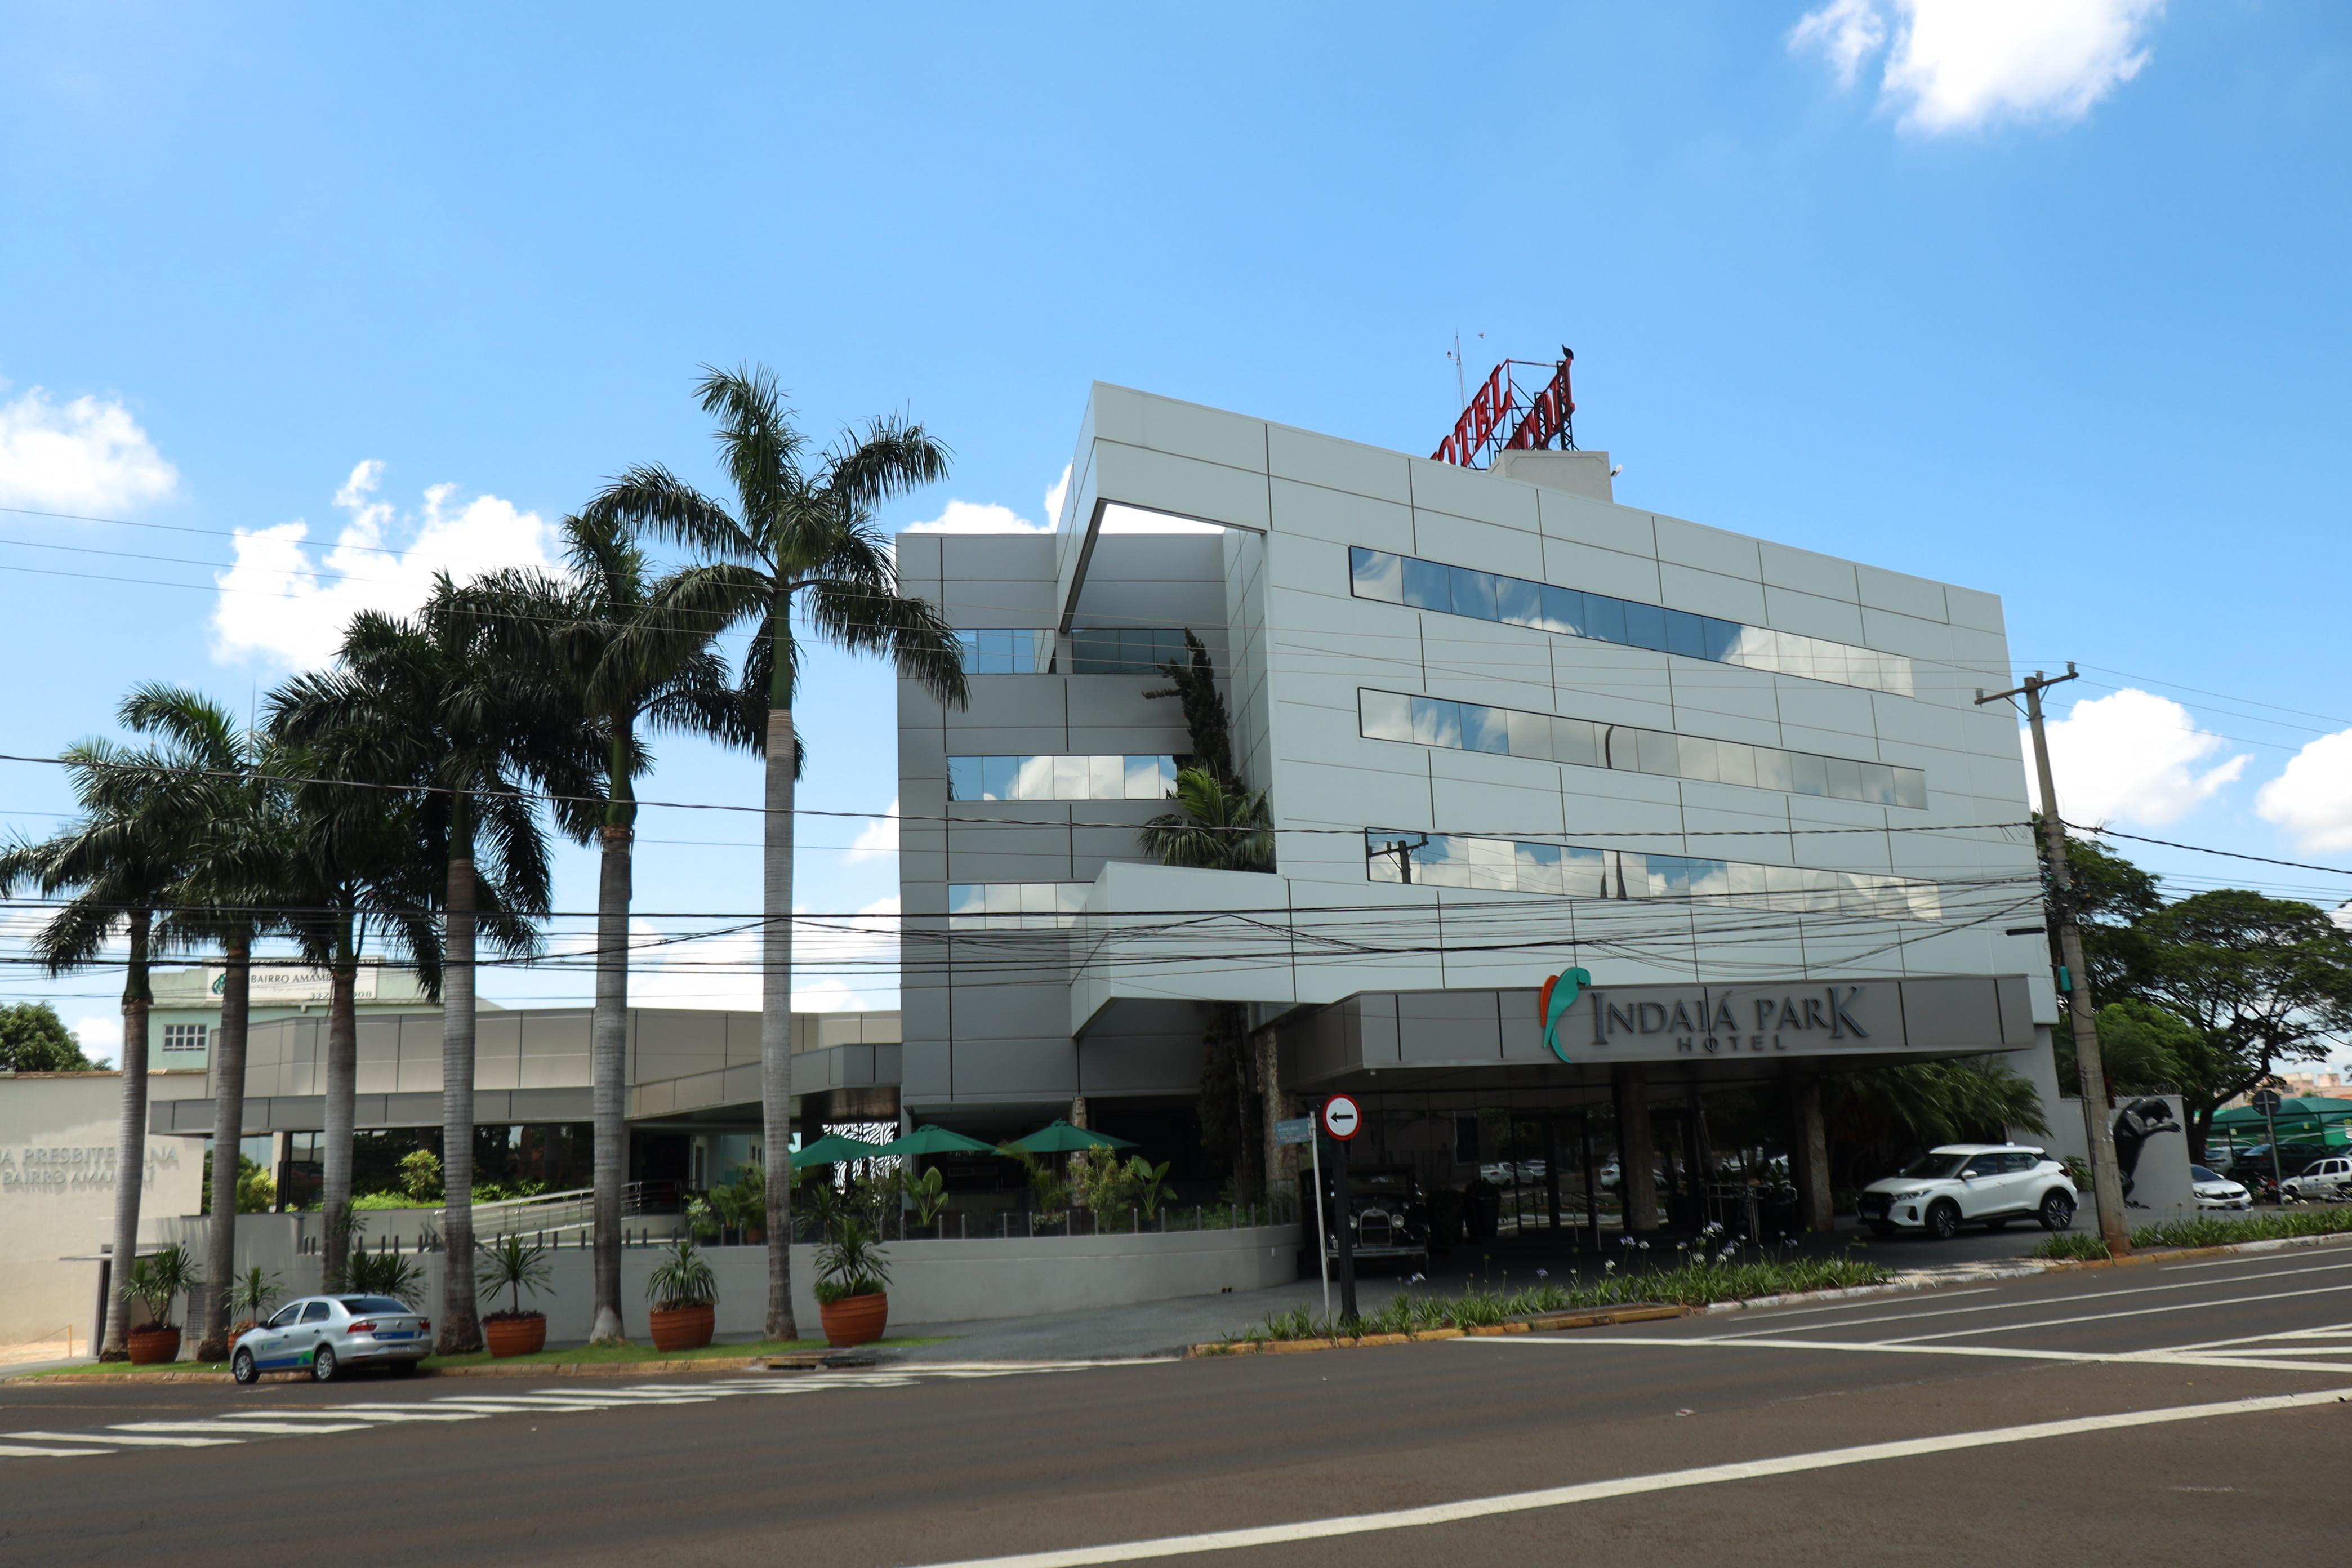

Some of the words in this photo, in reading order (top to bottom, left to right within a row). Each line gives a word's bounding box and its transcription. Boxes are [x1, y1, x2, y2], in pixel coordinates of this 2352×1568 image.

[1429, 364, 1513, 468] OTEL
[251, 974, 289, 983] BAIRRO
[1590, 990, 1739, 1045] INDAIÁ
[1756, 986, 1870, 1039] PARK
[1676, 1034, 1787, 1053] HOTEL
[23, 1146, 179, 1164] PRESBITENA
[2, 1170, 66, 1185] BAIRRO
